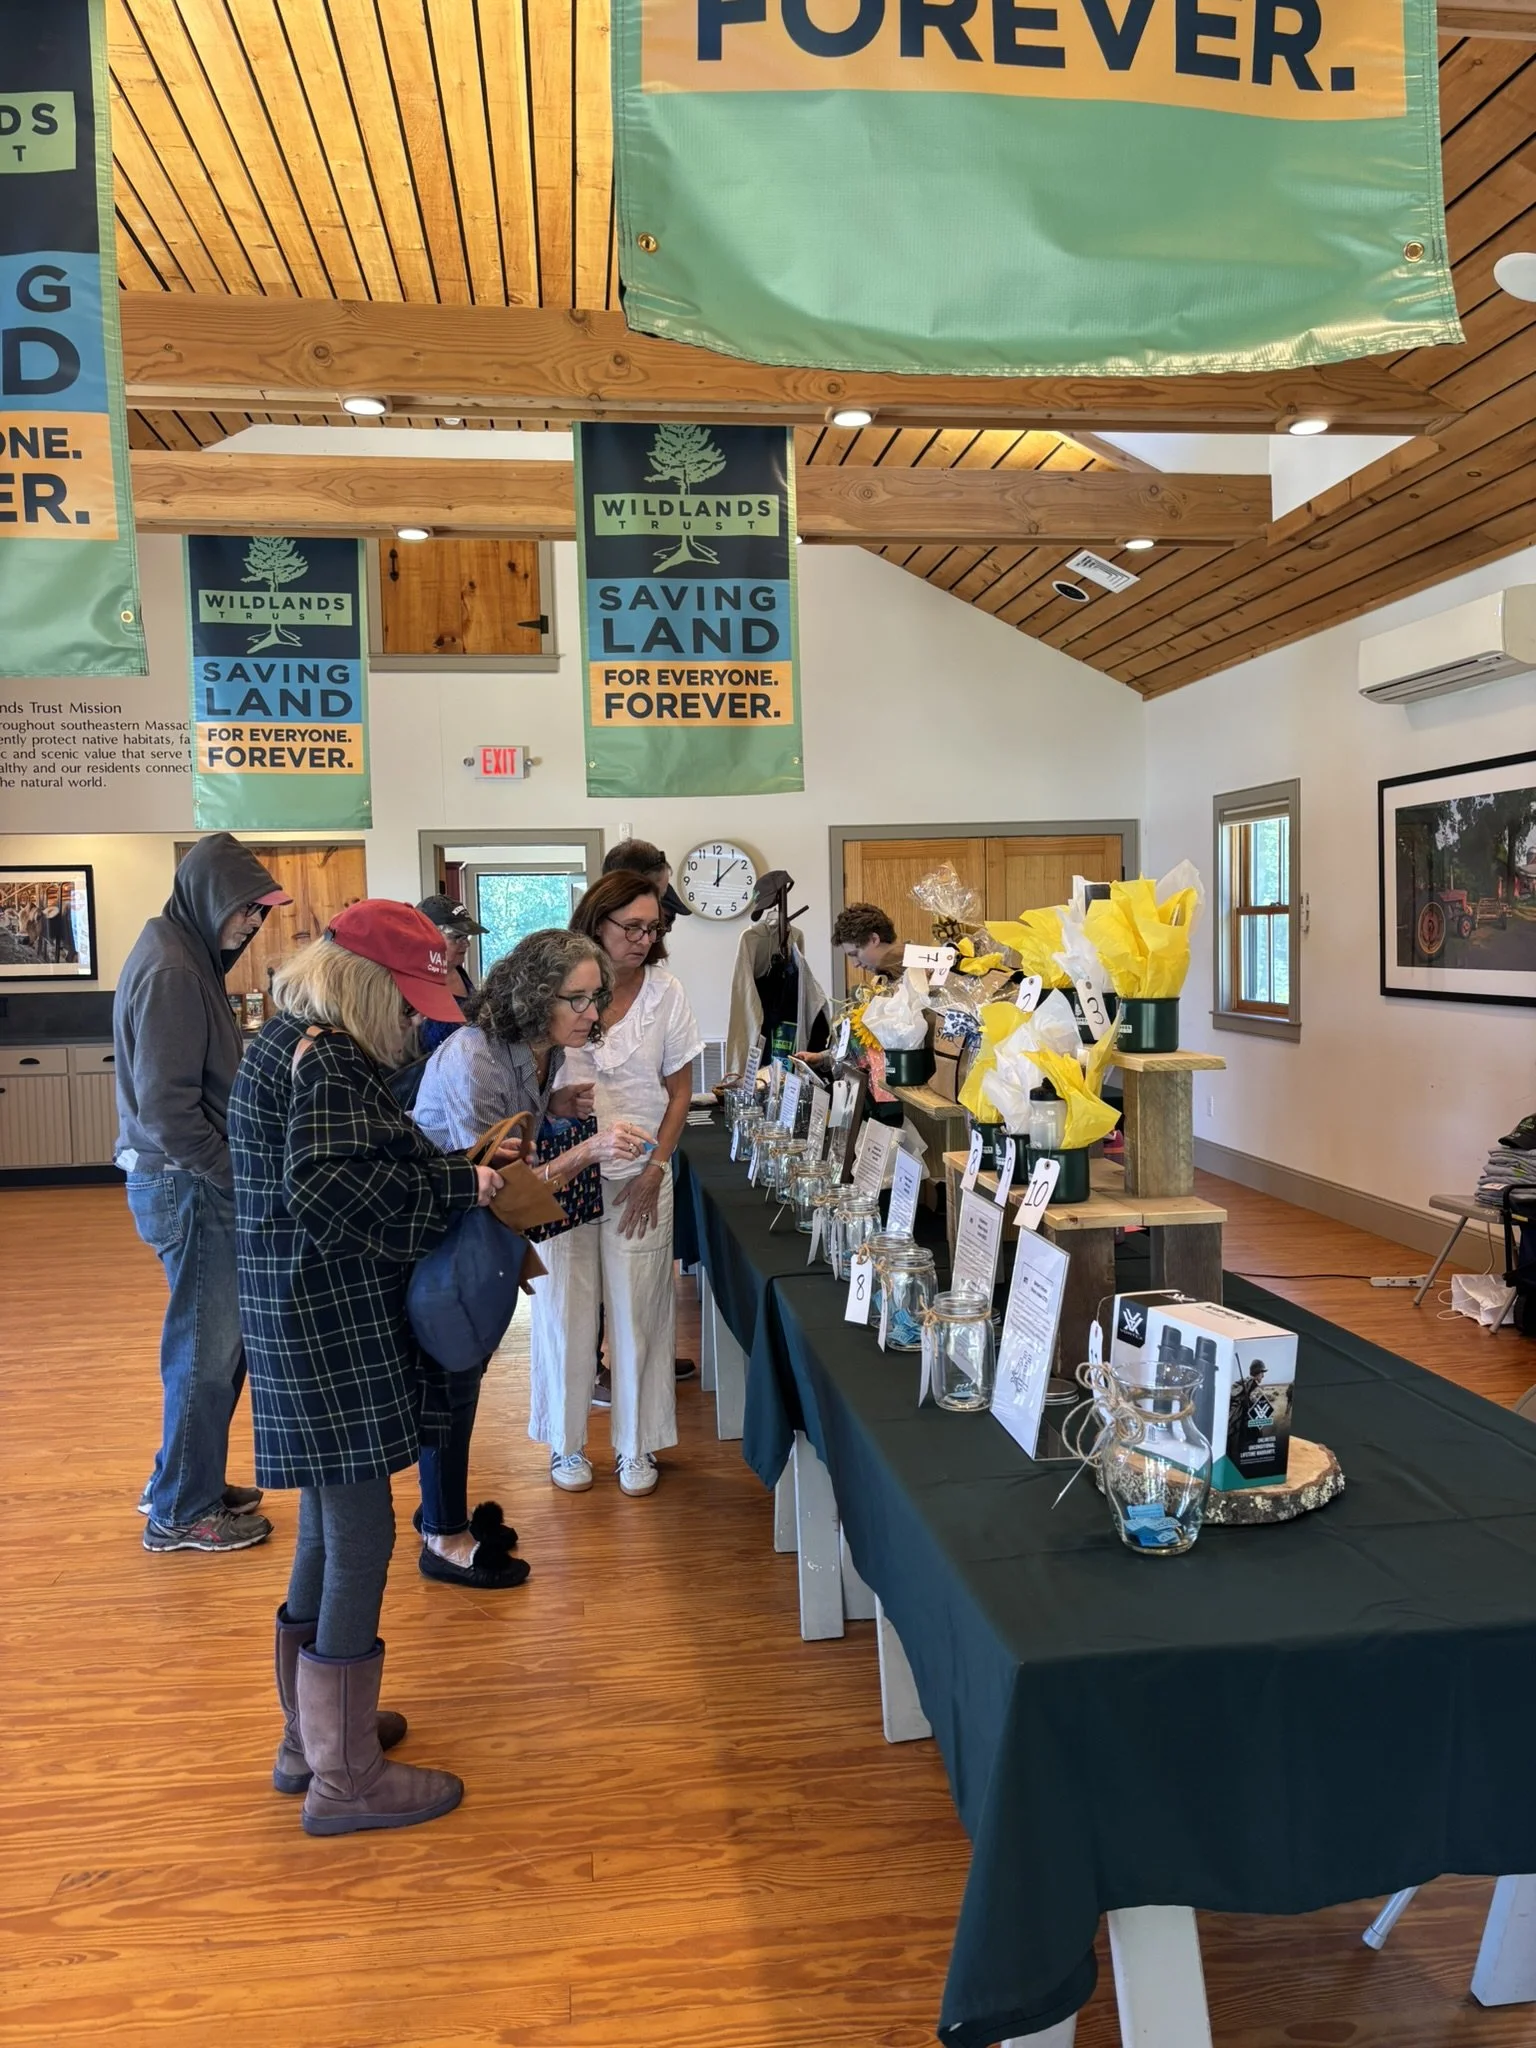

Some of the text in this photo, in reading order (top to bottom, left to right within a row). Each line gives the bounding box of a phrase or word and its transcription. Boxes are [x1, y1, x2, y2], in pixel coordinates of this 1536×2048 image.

[697, 0, 1355, 91] FOREVER.
[12, 145, 27, 162] T
[16, 264, 72, 313] G
[2, 326, 81, 395] D
[0, 427, 82, 459] NE.
[602, 500, 771, 518] WILDLANDS
[618, 520, 755, 531] TRUST
[205, 594, 345, 611] WILDLANDS
[598, 585, 776, 612] SAVING
[219, 611, 332, 621] TRUST
[602, 617, 780, 655] LAND
[203, 662, 350, 684] SAVING
[604, 669, 779, 686] FOR EVERYONE.
[29, 702, 63, 714] Trust
[69, 702, 122, 714] Mission
[206, 687, 353, 718] LAND
[604, 692, 781, 719] FOREVER.
[60, 720, 140, 731] southeastern
[144, 720, 192, 731] Massac
[32, 735, 77, 748] protect
[82, 735, 119, 745] native
[123, 733, 175, 747] habitats,
[208, 728, 352, 743] FOR EVERYONE.
[13, 748, 36, 760] and
[41, 748, 79, 760] scenic
[84, 748, 117, 760] value
[122, 748, 146, 760] that
[150, 751, 183, 760] serve
[208, 746, 354, 769] FOREVER.
[482, 748, 516, 775] EXIT
[33, 763, 56, 774] and
[61, 765, 82, 774] our
[86, 763, 141, 774] residents
[20, 777, 63, 788] natural
[68, 777, 107, 788] world.
[698, 849, 706, 859] 11
[712, 845, 722, 856] 12
[687, 861, 698, 871] 10
[741, 860, 748, 870] 2
[683, 876, 691, 886] 9
[746, 876, 753, 885] 3
[688, 892, 695, 901] 8
[741, 892, 748, 902] 4
[701, 902, 707, 912] 7
[715, 906, 722, 916] 6
[730, 902, 737, 911] 5
[1087, 997, 1105, 1025] 3
[969, 1149, 979, 1176] 8
[1024, 1180, 1049, 1207] 10
[856, 1273, 865, 1301] 8
